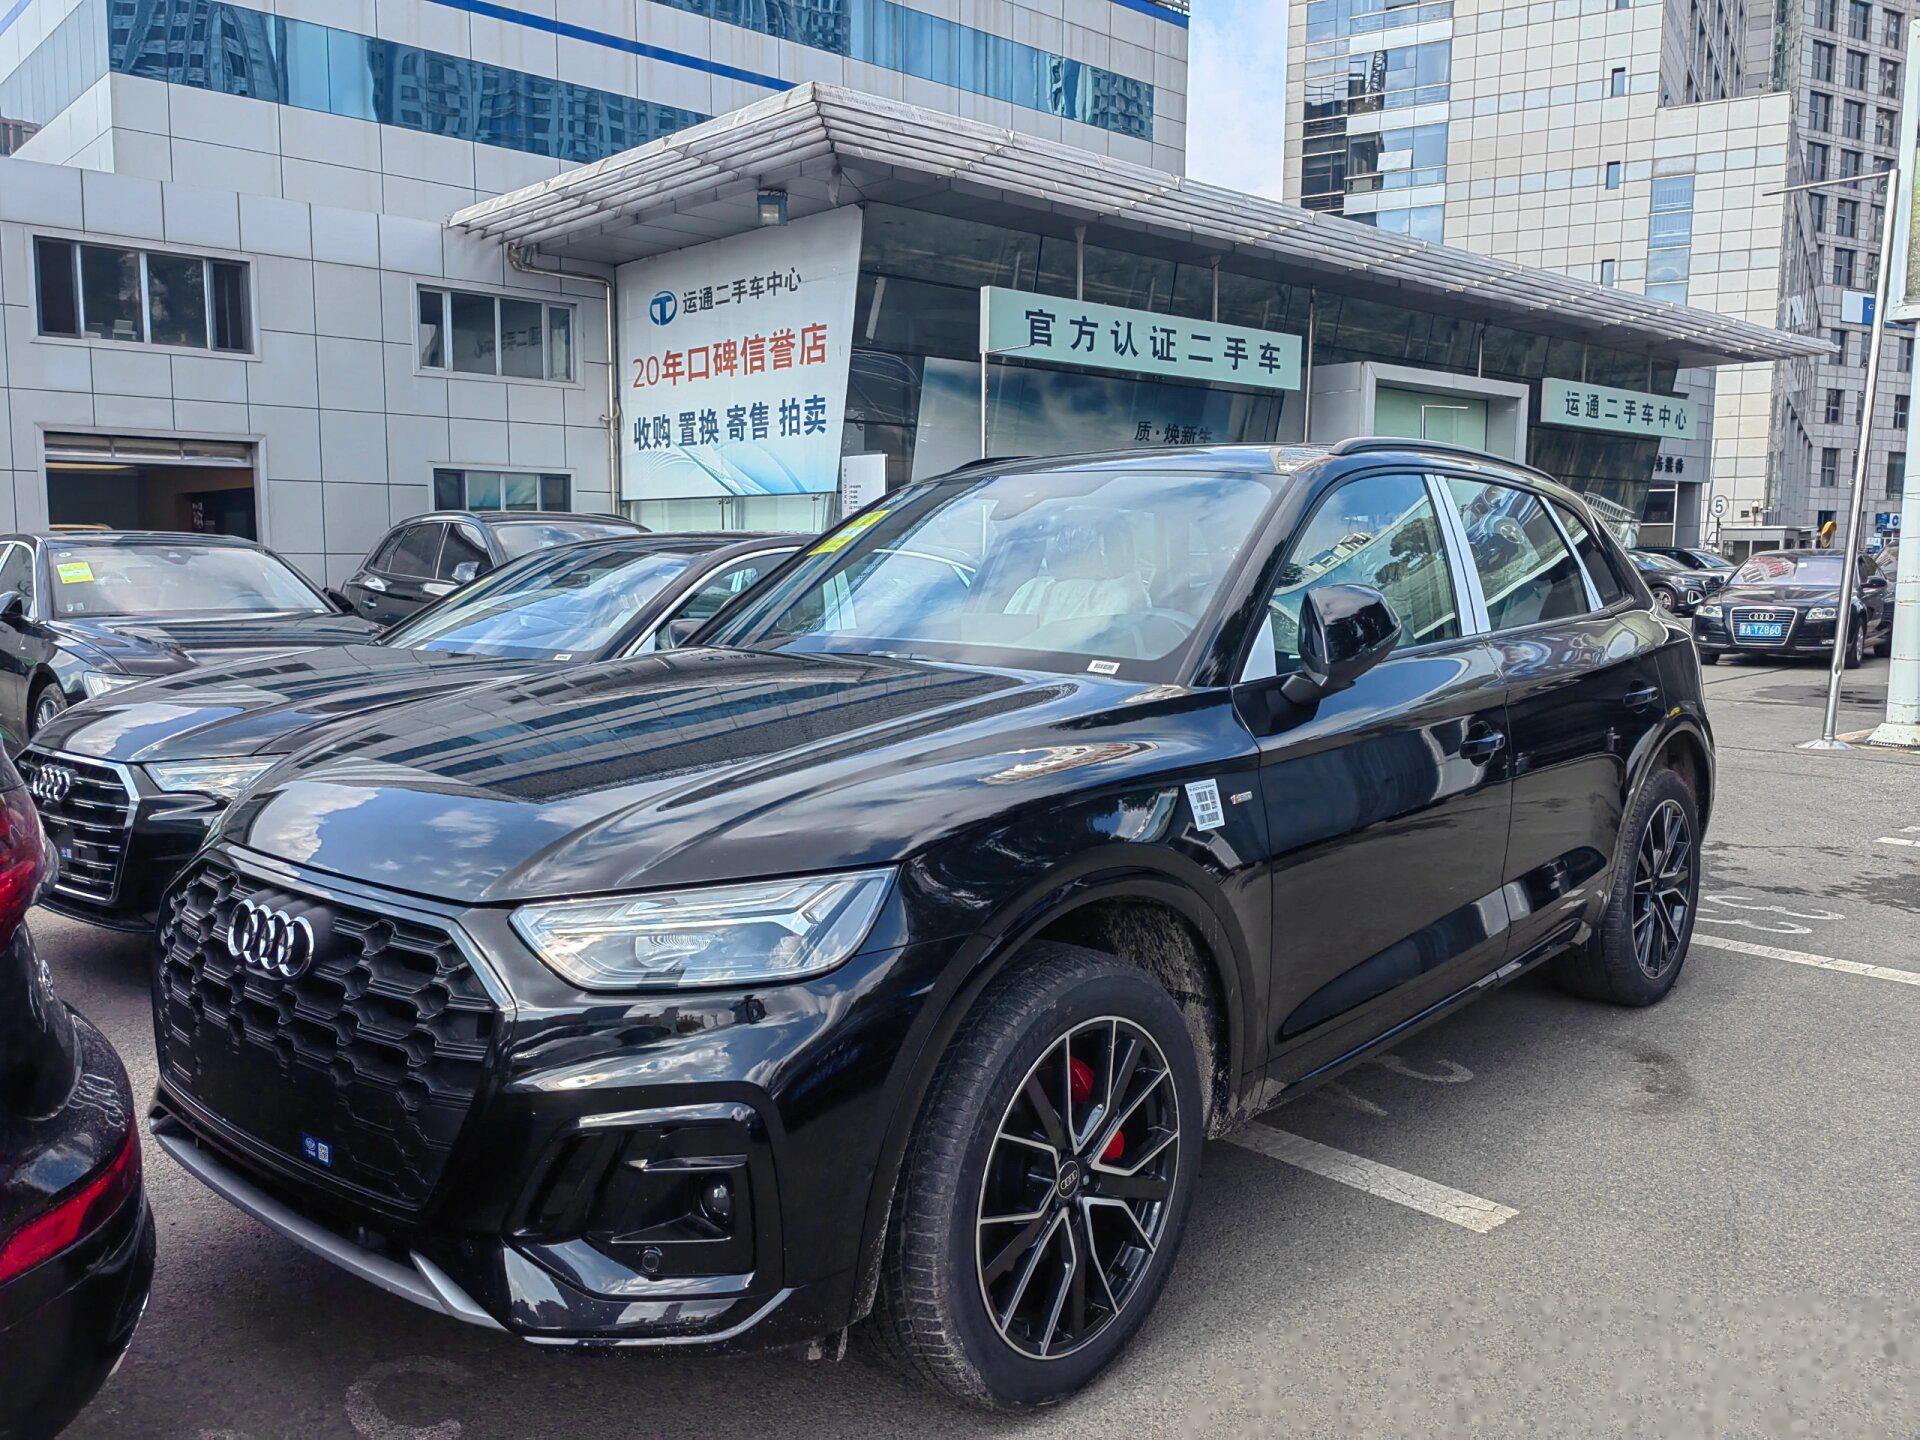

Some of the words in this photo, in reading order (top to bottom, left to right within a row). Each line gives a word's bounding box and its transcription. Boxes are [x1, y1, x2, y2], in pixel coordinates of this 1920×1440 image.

[682, 267, 802, 315] 运通二手车中心
[632, 322, 828, 388] 20年口碑信誉店
[1025, 308, 1281, 375] 官方认证二手车
[633, 414, 671, 451] 收购
[678, 408, 720, 448] 置换
[726, 401, 770, 442] 寄售
[778, 394, 827, 437] 拍卖
[1565, 390, 1687, 430] 运通二手车中心
[1714, 499, 1724, 514] 5
